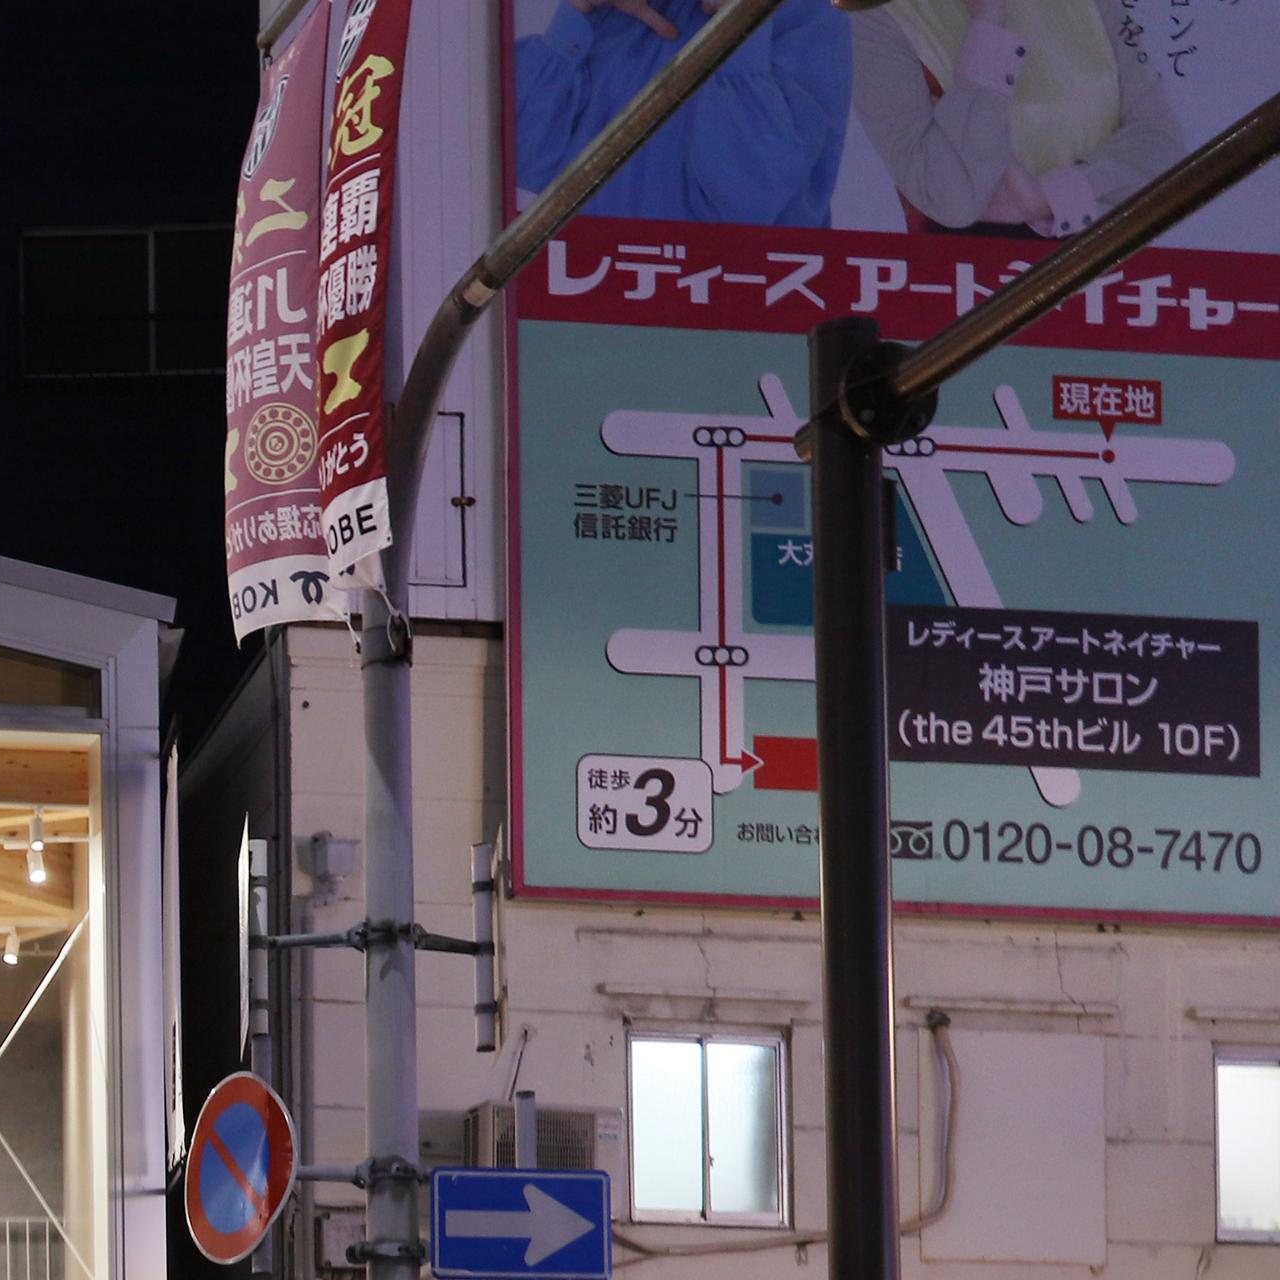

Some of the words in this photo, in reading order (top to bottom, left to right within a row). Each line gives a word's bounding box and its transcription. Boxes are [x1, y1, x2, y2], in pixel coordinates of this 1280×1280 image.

[1168, 0, 1197, 77] ンで
[547, 240, 826, 311] レディース
[845, 256, 1279, 331] アートイチャー
[1059, 384, 1155, 417] 現在地
[574, 483, 677, 511] 三菱UFJ
[574, 513, 678, 543] 信託銀行
[979, 663, 1158, 706] 神戸サロン
[898, 709, 973, 747] (the
[981, 715, 1141, 754] 45thビル
[1158, 722, 1240, 761] 10F)
[588, 768, 631, 790] 徒歩
[943, 819, 1262, 875] 0120-08-7470
